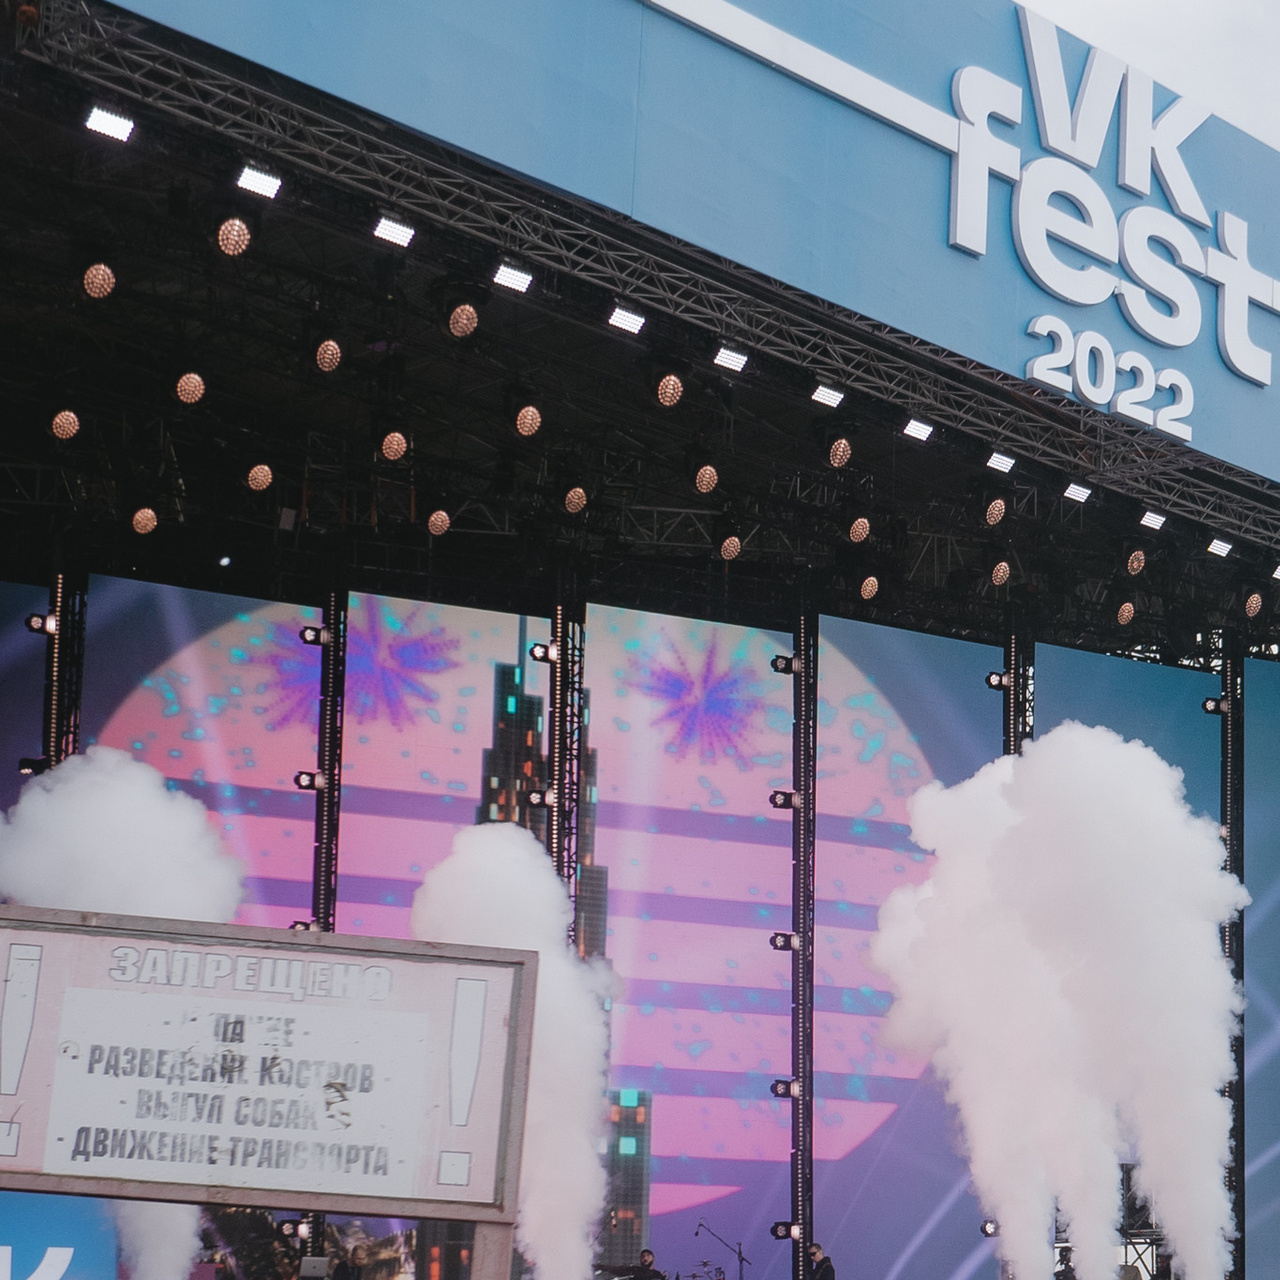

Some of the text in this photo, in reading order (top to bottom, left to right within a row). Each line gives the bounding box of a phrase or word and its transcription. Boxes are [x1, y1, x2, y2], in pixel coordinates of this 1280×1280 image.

[1016, 5, 1213, 229] VK
[949, 65, 1272, 388] fest
[1026, 315, 1194, 442] 2022
[108, 946, 392, 1001] ЗАПРЕЩЕНО
[71, 1126, 219, 1165] ДВИЖЕНИЕ
